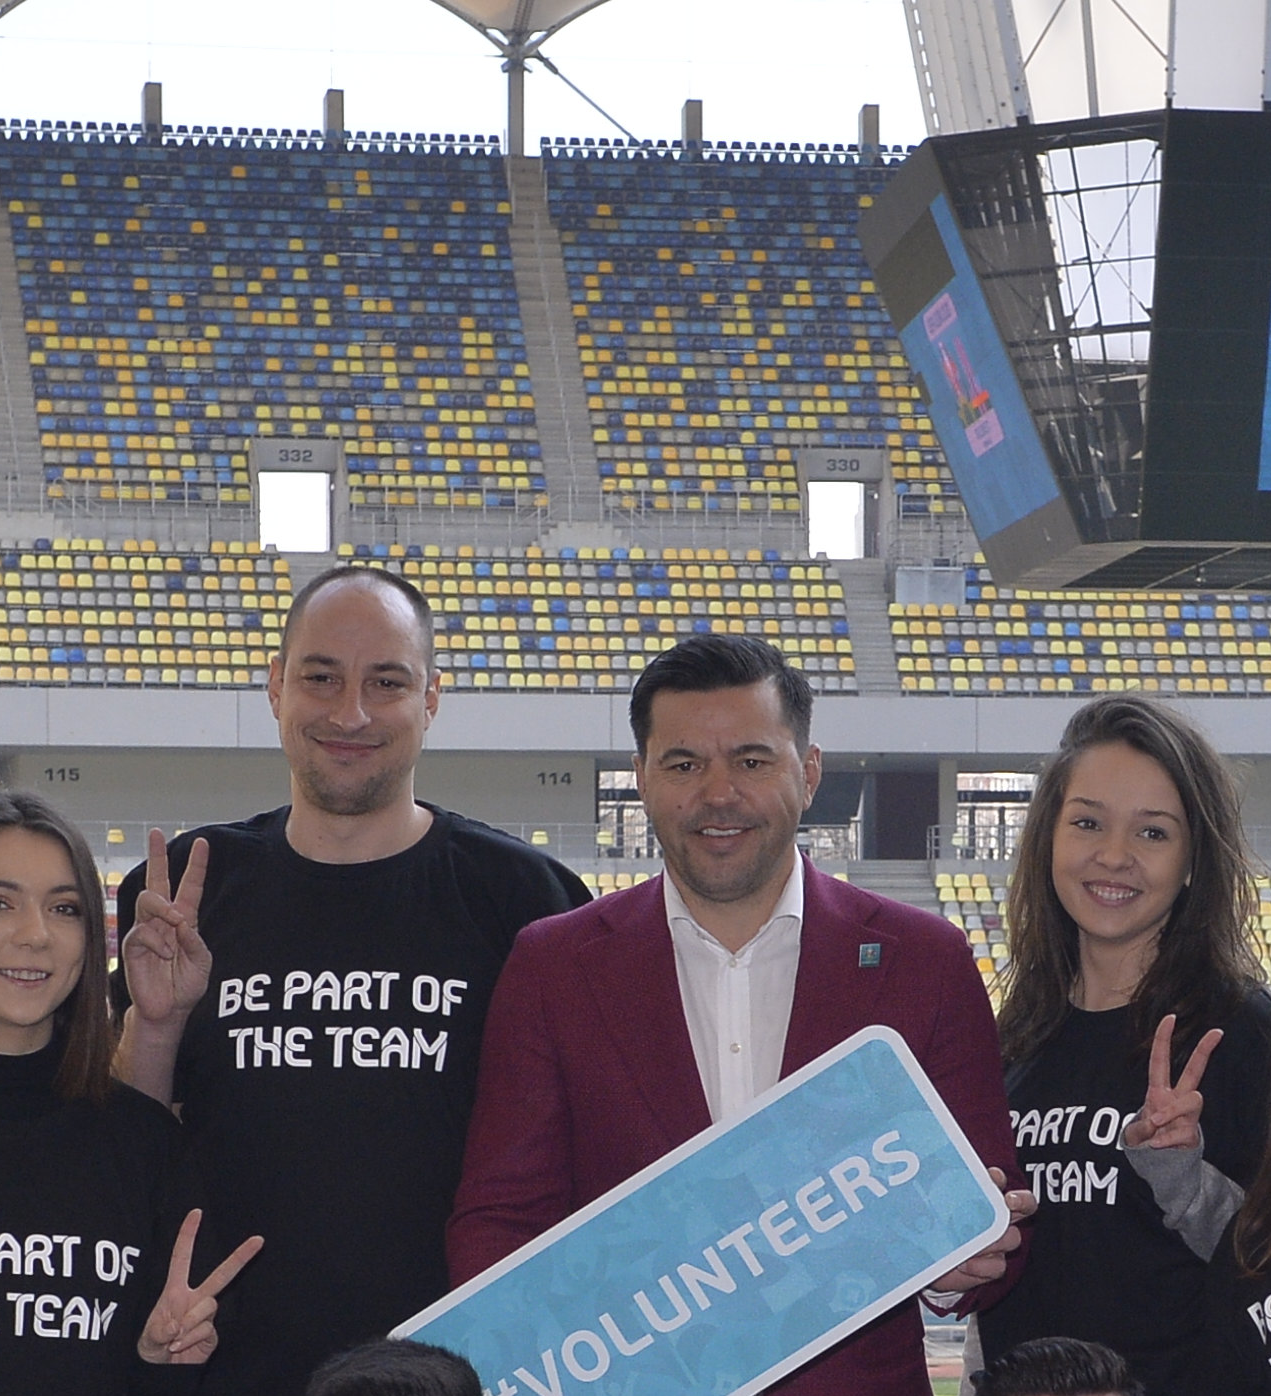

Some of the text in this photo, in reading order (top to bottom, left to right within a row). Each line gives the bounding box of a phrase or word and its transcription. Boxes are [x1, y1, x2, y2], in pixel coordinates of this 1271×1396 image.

[278, 448, 313, 463] 332
[826, 458, 861, 472] 330
[44, 767, 80, 782] 115
[537, 772, 572, 787] 114
[218, 970, 468, 1018] BE PART OF
[228, 1025, 448, 1072] THE TEAM
[1025, 1160, 1119, 1205] TEAM
[95, 1240, 141, 1286] OF
[6, 1291, 118, 1341] TEAM
